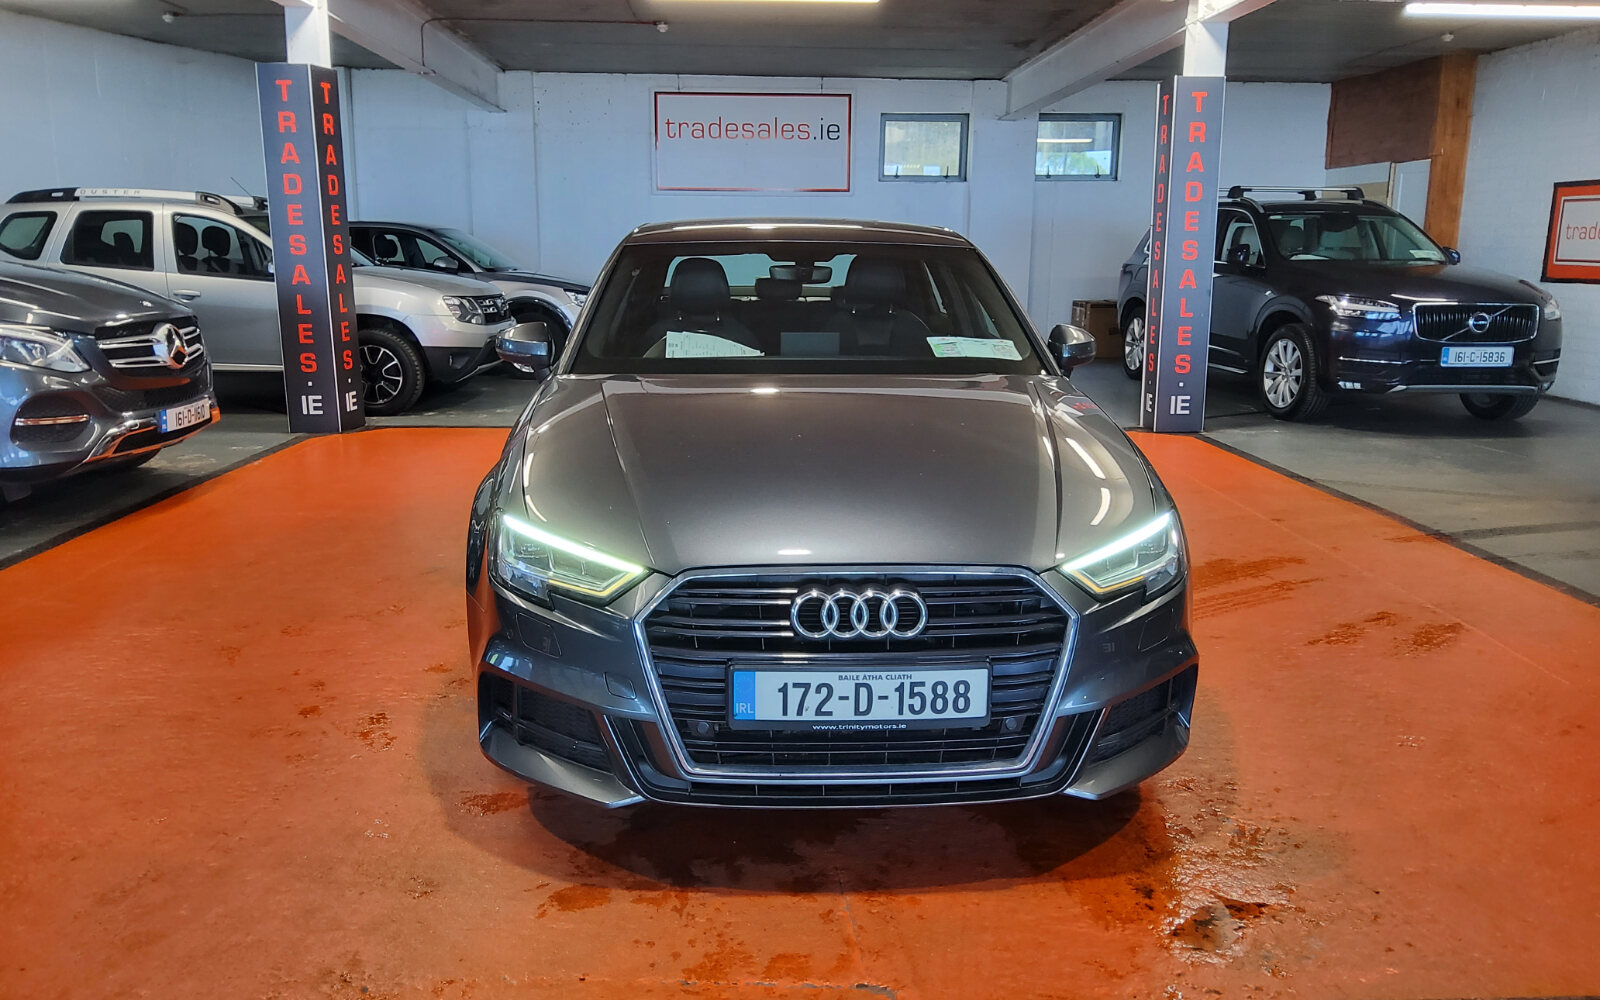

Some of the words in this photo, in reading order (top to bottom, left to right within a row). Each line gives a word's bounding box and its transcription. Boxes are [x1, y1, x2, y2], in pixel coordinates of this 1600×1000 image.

[665, 116, 841, 141] tradesales.ie
[1454, 351, 1506, 363] 161-C-15836
[777, 680, 971, 717] 172-D-1588
[735, 702, 755, 714] IRL
[812, 722, 907, 731] www.trinitymotors.ie
